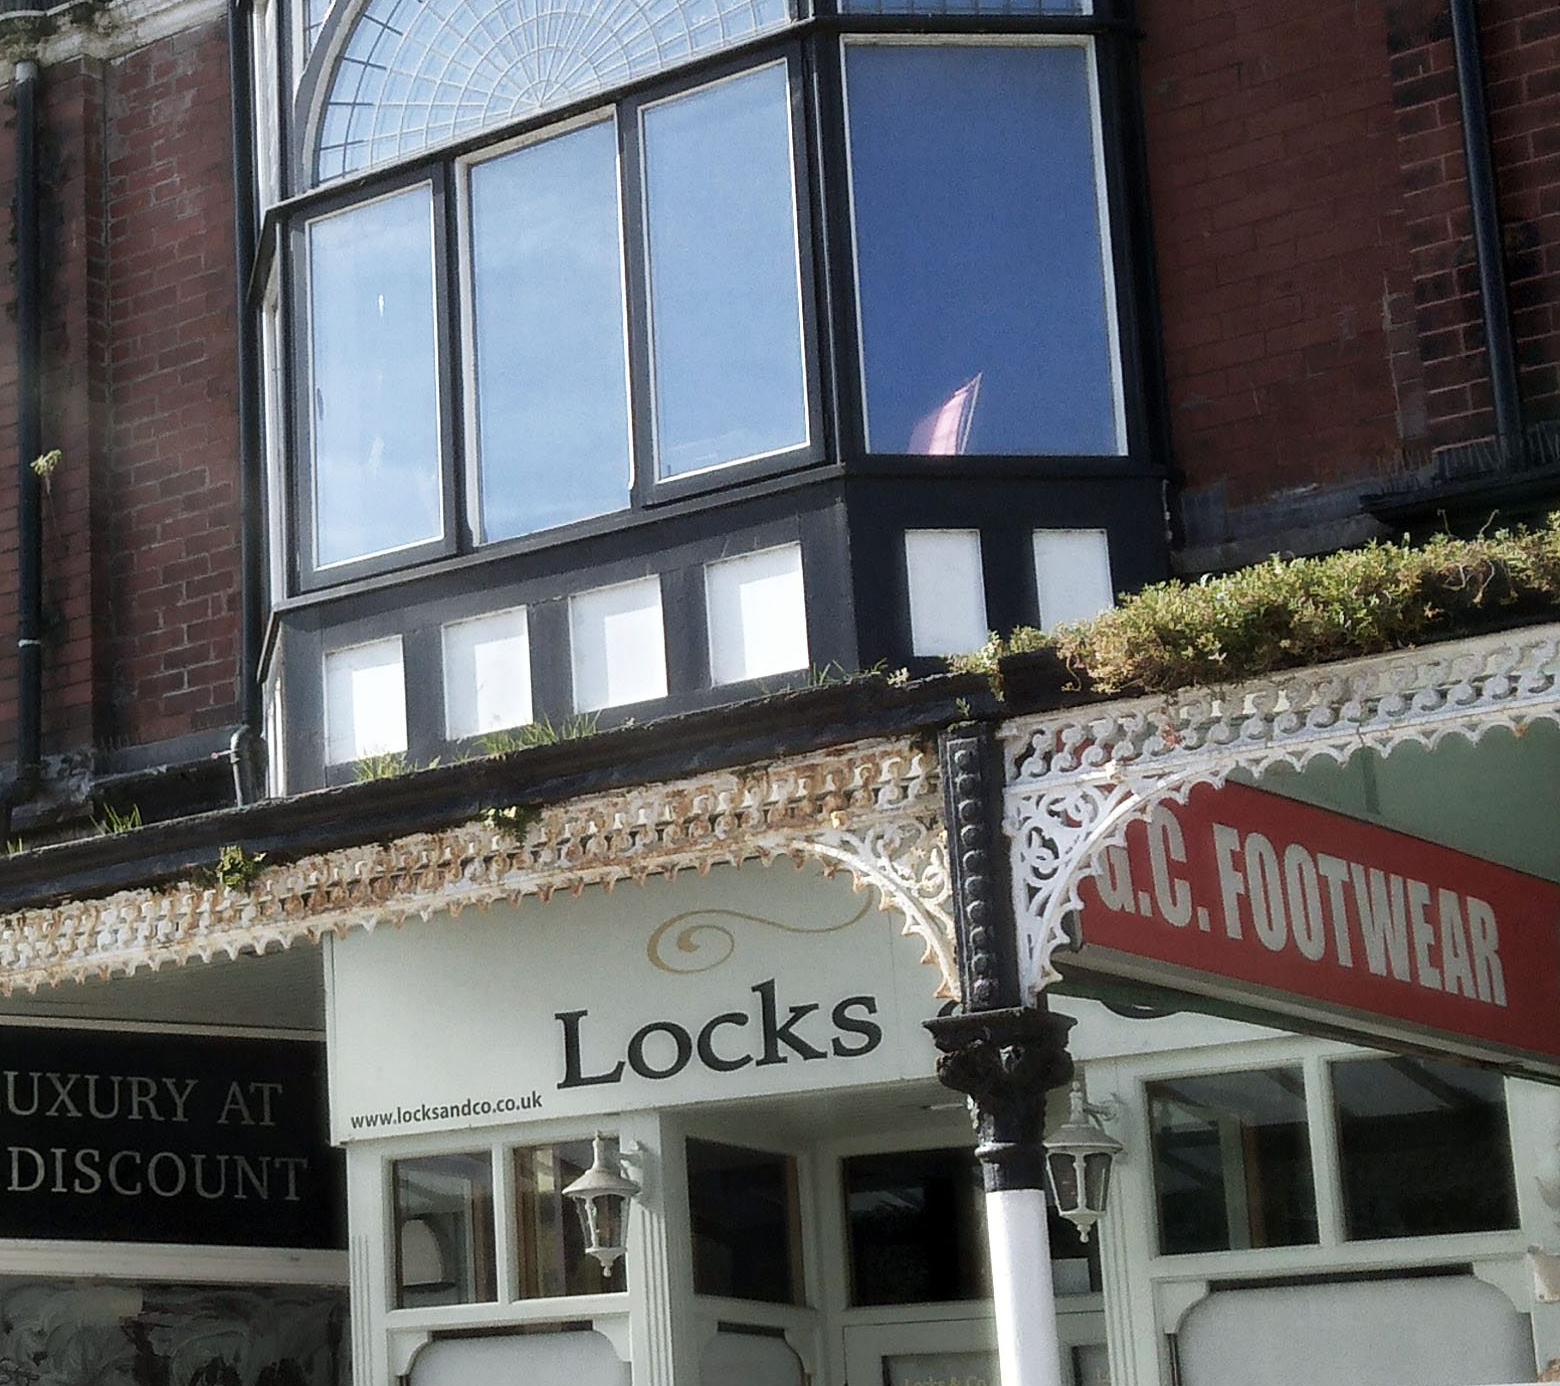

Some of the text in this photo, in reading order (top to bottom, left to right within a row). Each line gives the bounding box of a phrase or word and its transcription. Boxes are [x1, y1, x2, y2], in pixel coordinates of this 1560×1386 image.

[1095, 803, 1507, 1008] G.C. FOOTWEAR
[554, 977, 883, 1090] Locks
[217, 1081, 283, 1126] AT
[350, 1090, 543, 1130] www.locksandco.co.uk
[7, 1146, 309, 1201] DISCOUNT
